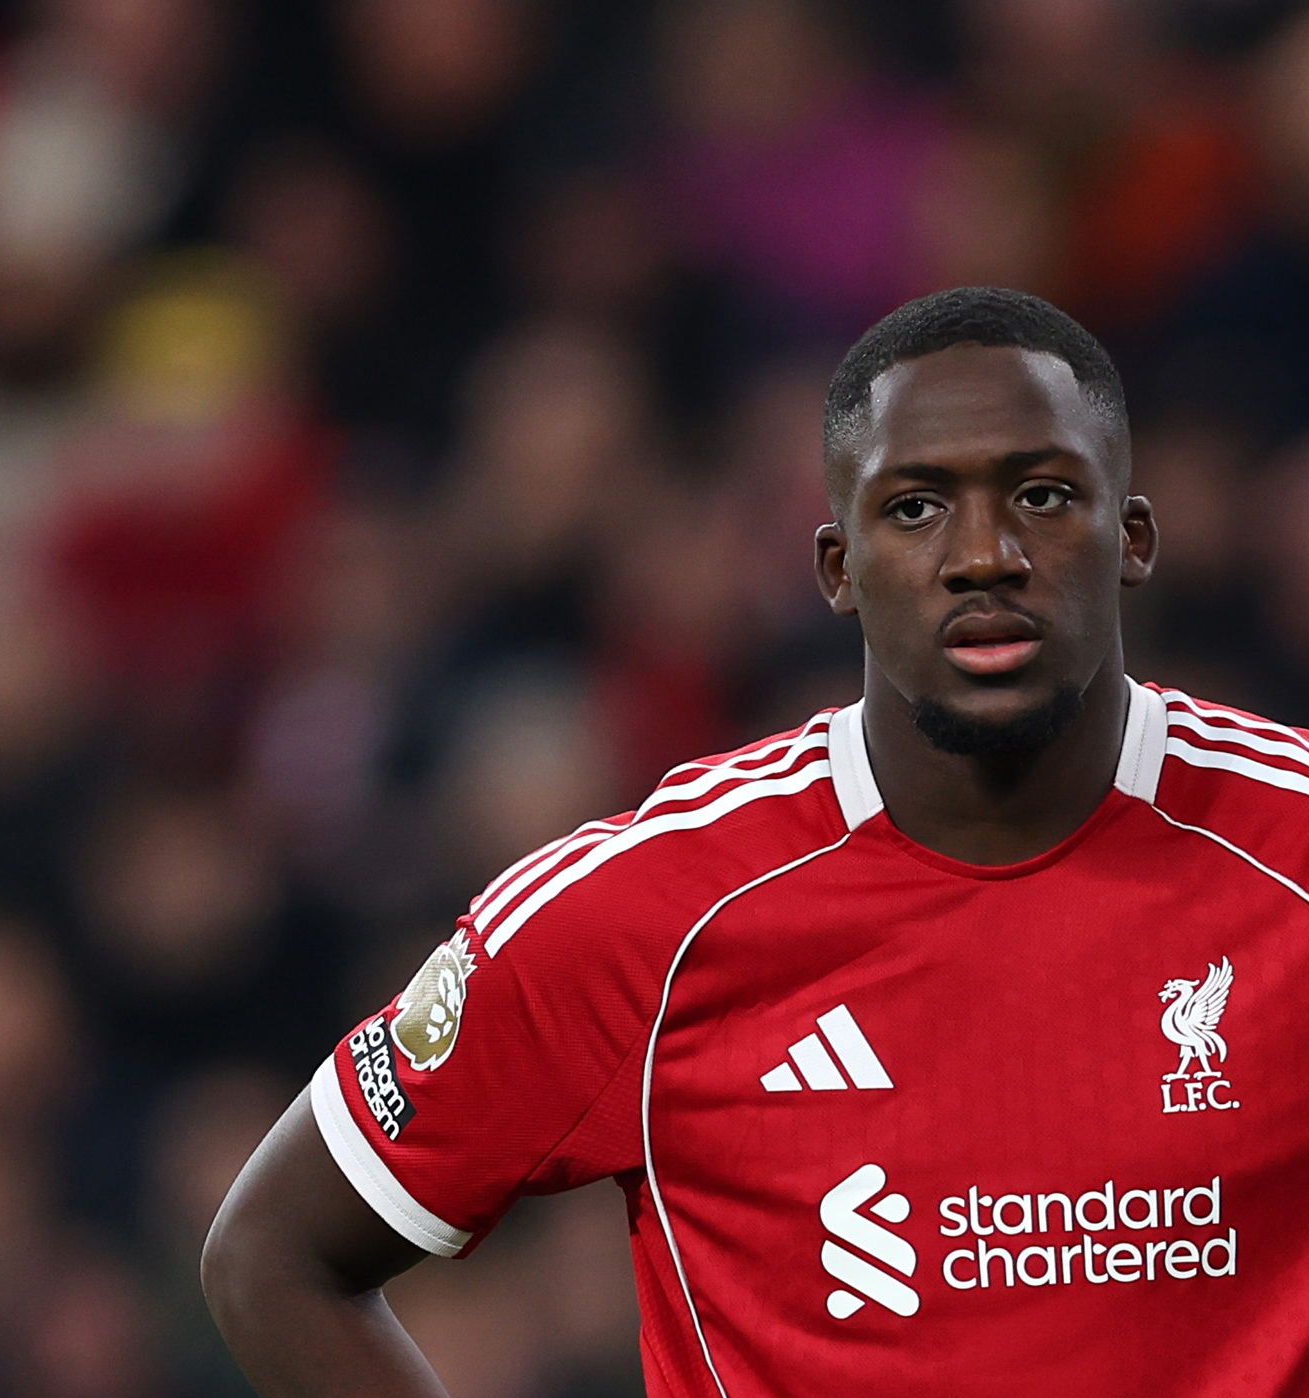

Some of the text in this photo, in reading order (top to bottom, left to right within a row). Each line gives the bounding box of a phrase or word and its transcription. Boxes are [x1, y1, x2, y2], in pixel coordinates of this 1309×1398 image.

[349, 1030, 400, 1141] or racism
[371, 1045, 405, 1116] room
[1160, 1080, 1240, 1113] L.F.C.
[939, 1176, 1220, 1237] standard
[942, 1227, 1237, 1290] chartered
